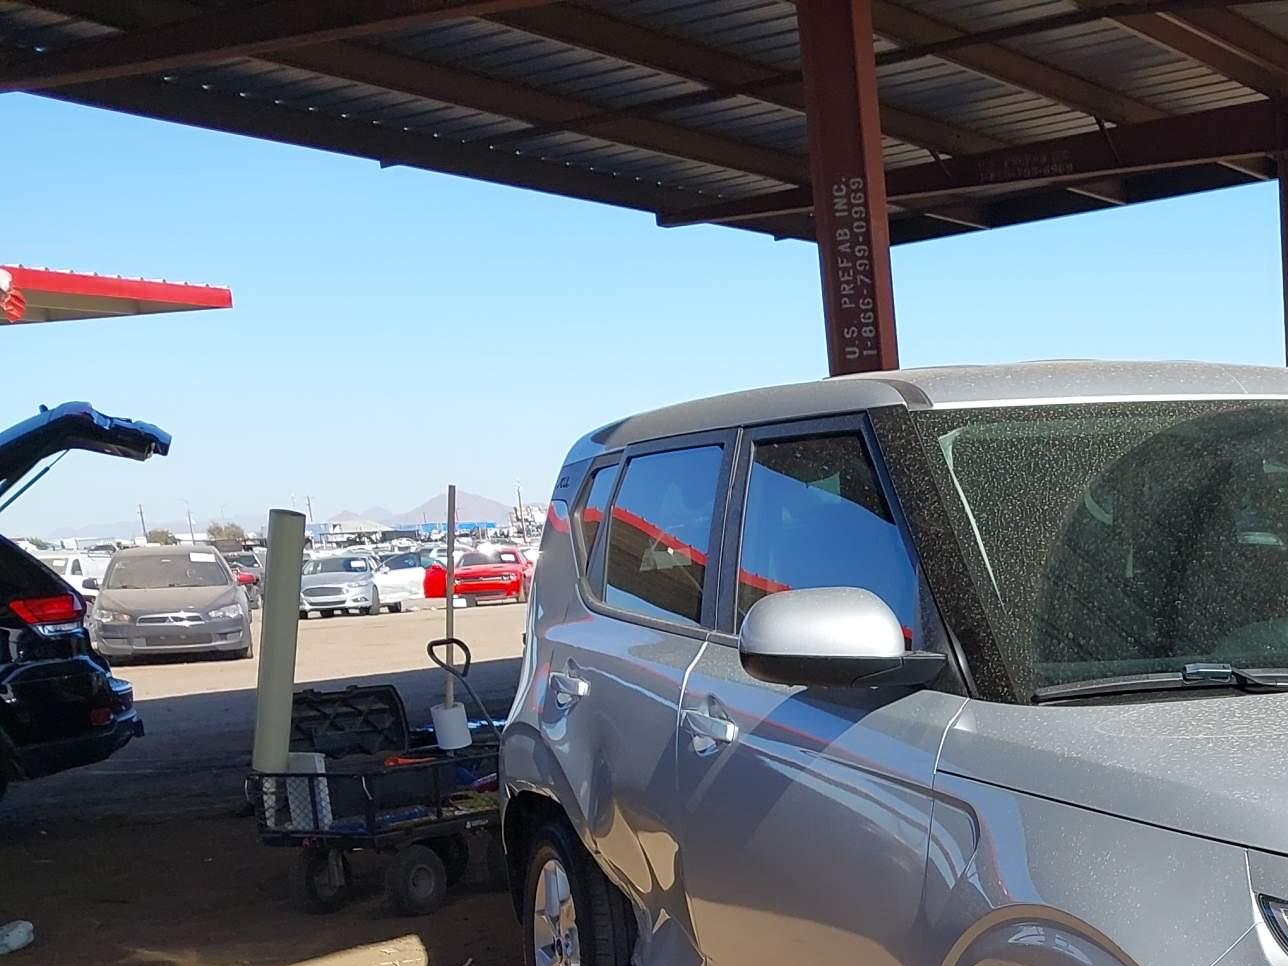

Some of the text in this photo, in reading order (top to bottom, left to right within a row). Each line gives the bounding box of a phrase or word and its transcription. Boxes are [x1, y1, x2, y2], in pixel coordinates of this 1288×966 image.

[832, 176, 850, 217] INC.
[835, 228, 857, 309] PREFAB
[850, 176, 878, 357] 1-866-799-0969
